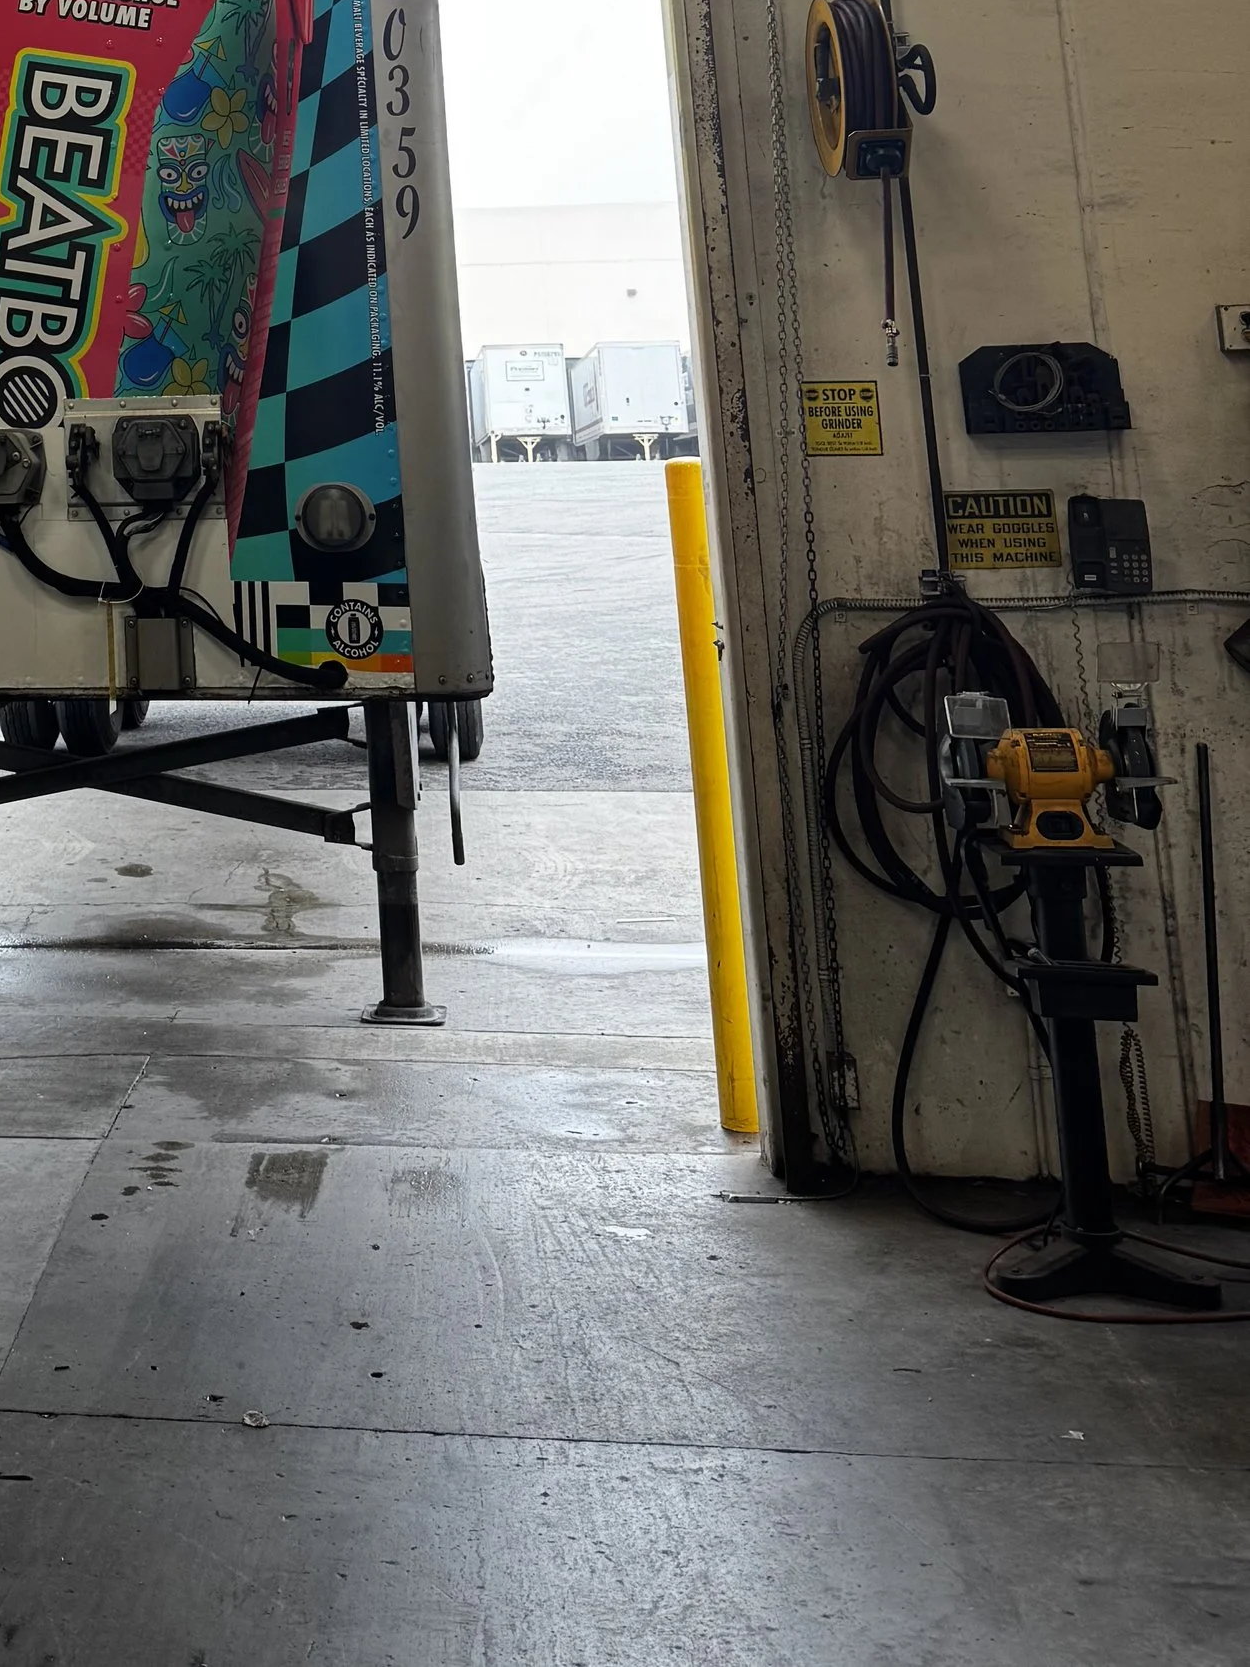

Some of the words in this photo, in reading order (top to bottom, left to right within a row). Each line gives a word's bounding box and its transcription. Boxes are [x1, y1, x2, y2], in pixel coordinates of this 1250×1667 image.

[352, 0, 363, 21] MALT
[354, 23, 365, 64] BEVERAGE
[356, 66, 368, 108] SPECIALTY
[359, 109, 368, 119] IN
[359, 122, 370, 154] LIMITED
[361, 156, 374, 204] LOCATIONS,
[364, 208, 374, 229] EACH
[365, 231, 375, 242] AS
[366, 245, 377, 288] INDICATED
[368, 290, 378, 303] ON
[369, 305, 382, 359] PACKAGING.
[372, 362, 383, 392] 11.1%
[822, 388, 856, 401] STOP
[373, 393, 385, 436] ALC/VOL.
[808, 406, 842, 417] BEFORE
[844, 405, 874, 417] USING
[821, 418, 862, 430] GRINDER
[948, 495, 1046, 518] CAUTION
[947, 523, 984, 535] WEAR
[992, 522, 1055, 534] GOGGLES
[958, 537, 996, 549] WHEN
[1004, 537, 1047, 548] USING
[950, 552, 984, 563] THIS
[993, 551, 1057, 562] MACHINE
[330, 602, 378, 624] CONTAINS
[332, 640, 379, 658] ALCOHOL
